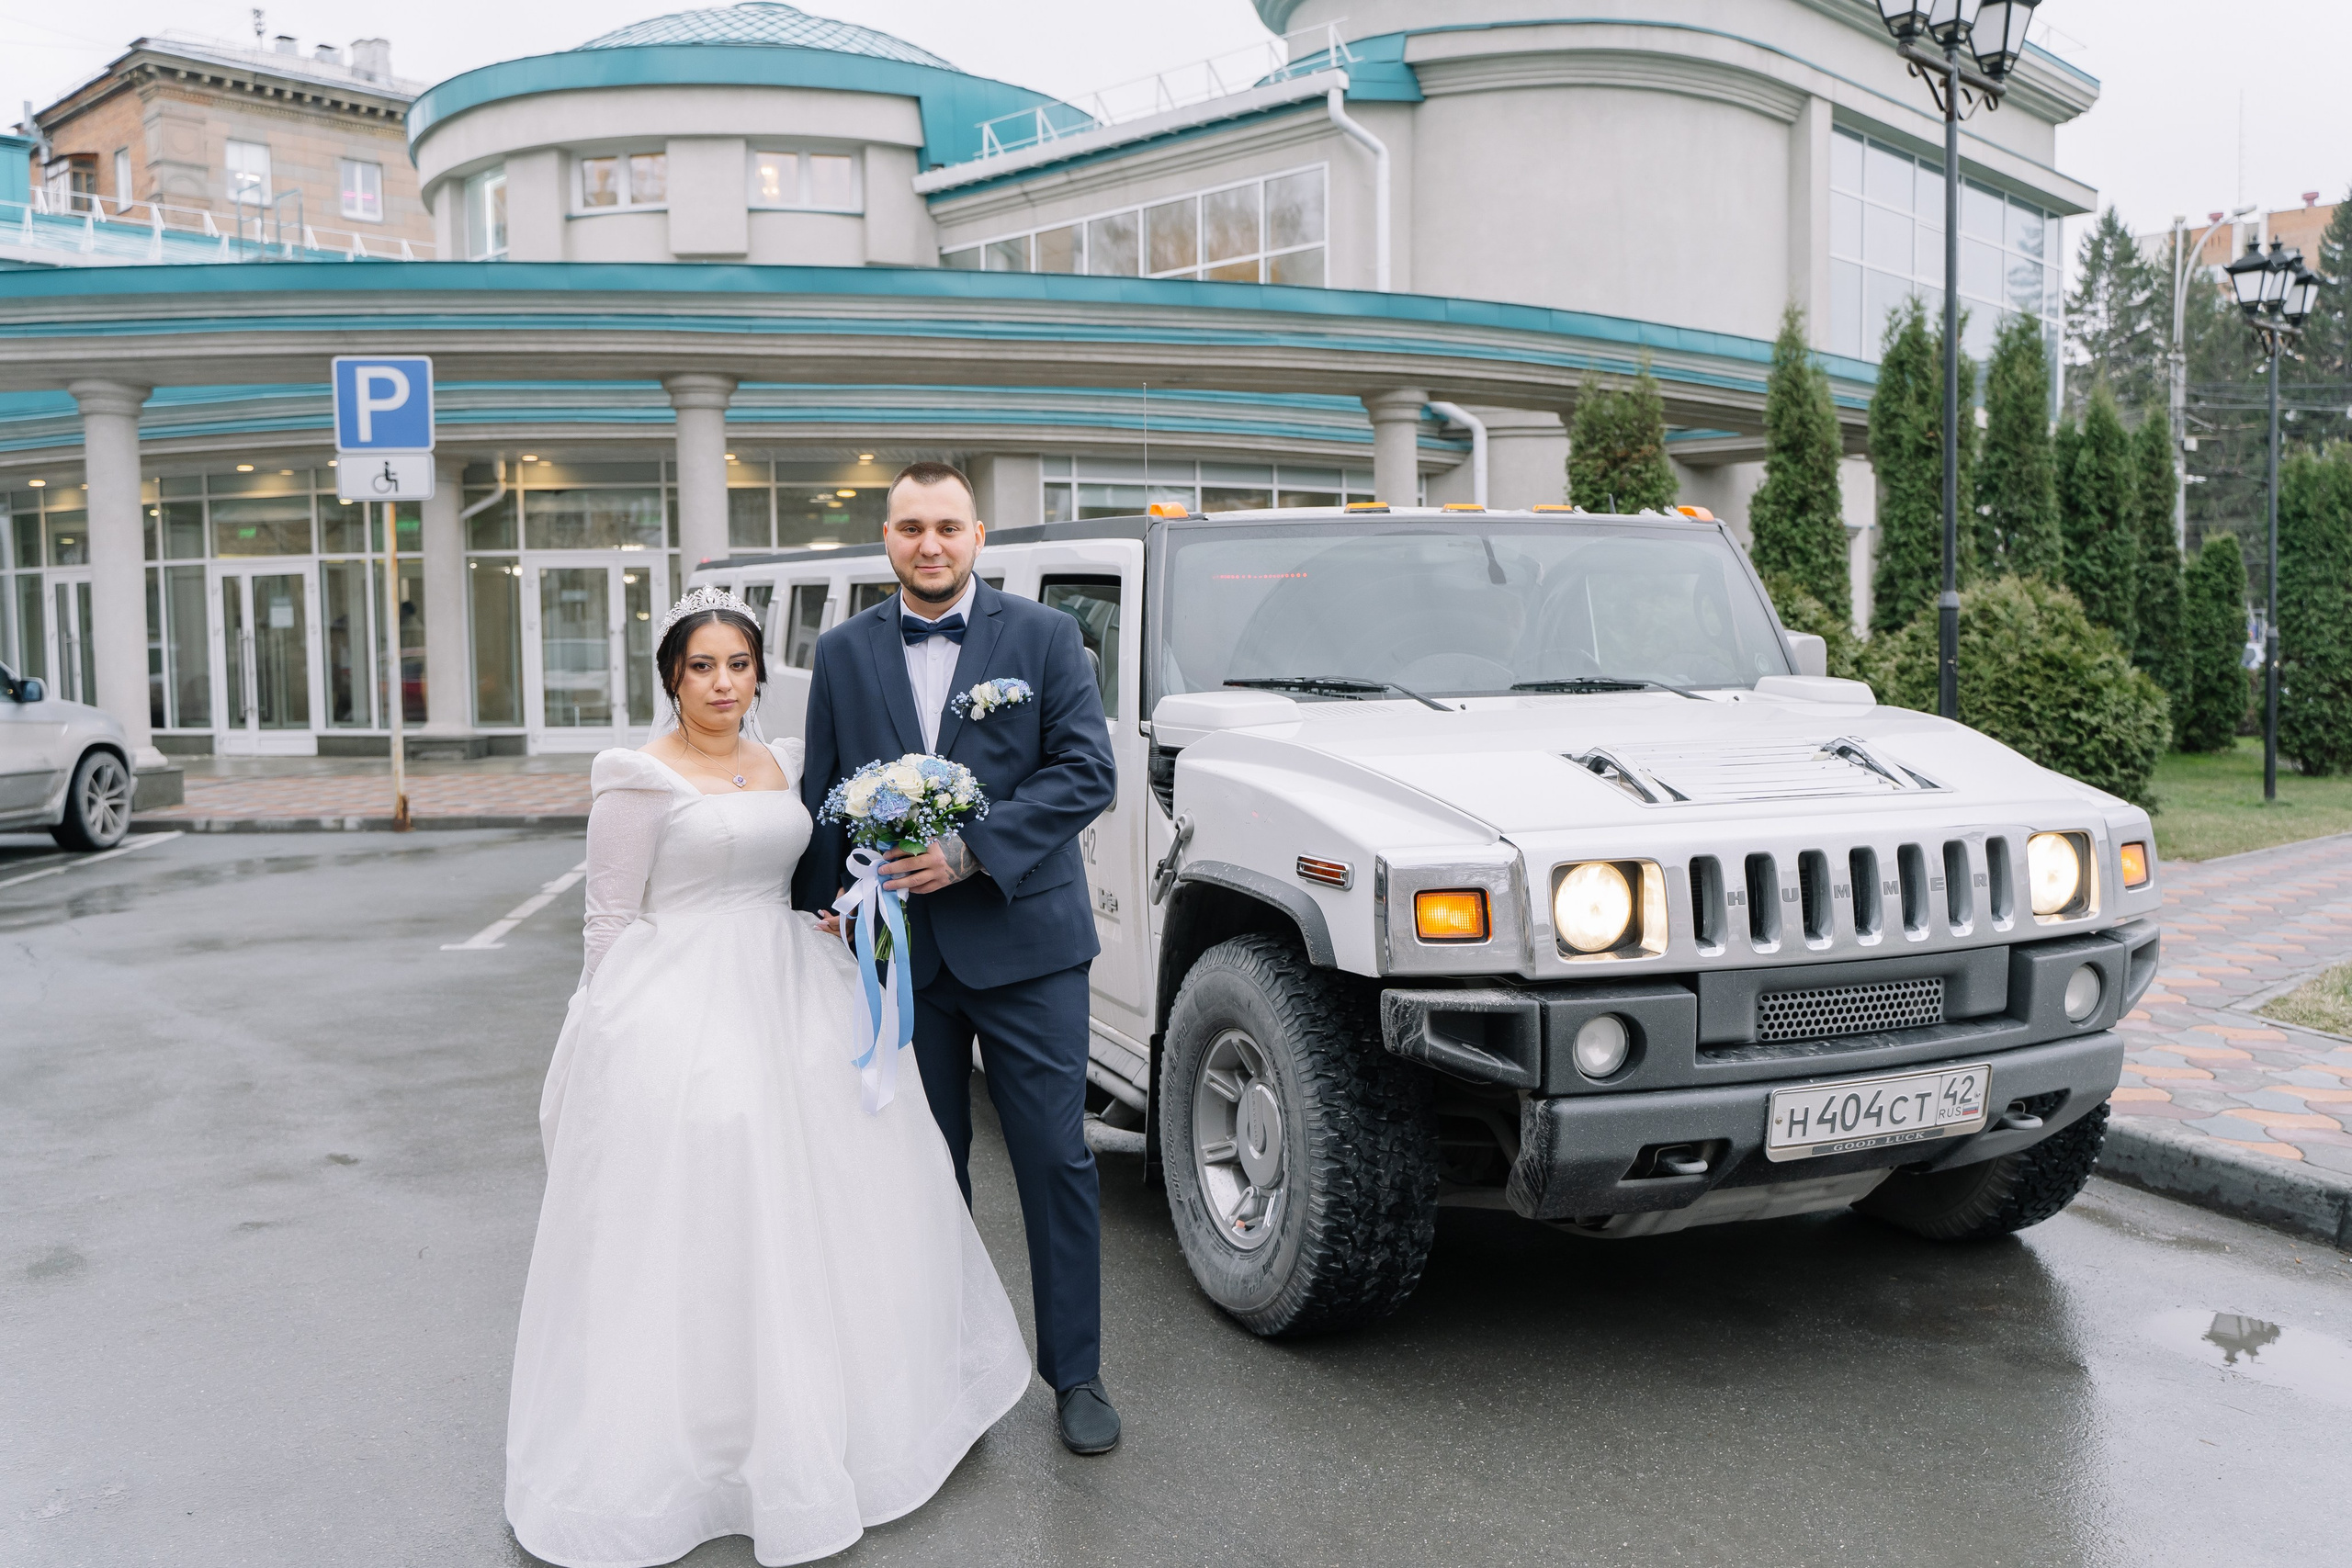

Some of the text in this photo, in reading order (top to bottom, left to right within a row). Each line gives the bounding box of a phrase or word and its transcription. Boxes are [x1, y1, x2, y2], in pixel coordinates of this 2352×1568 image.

[355, 366, 411, 443] P
[1082, 827, 1097, 865] H2
[1726, 873, 1988, 907] HUMMER
[1943, 1075, 1975, 1106] 42
[1938, 1106, 1962, 1120] RUS
[1833, 1131, 1926, 1152] GOOD LUCK
